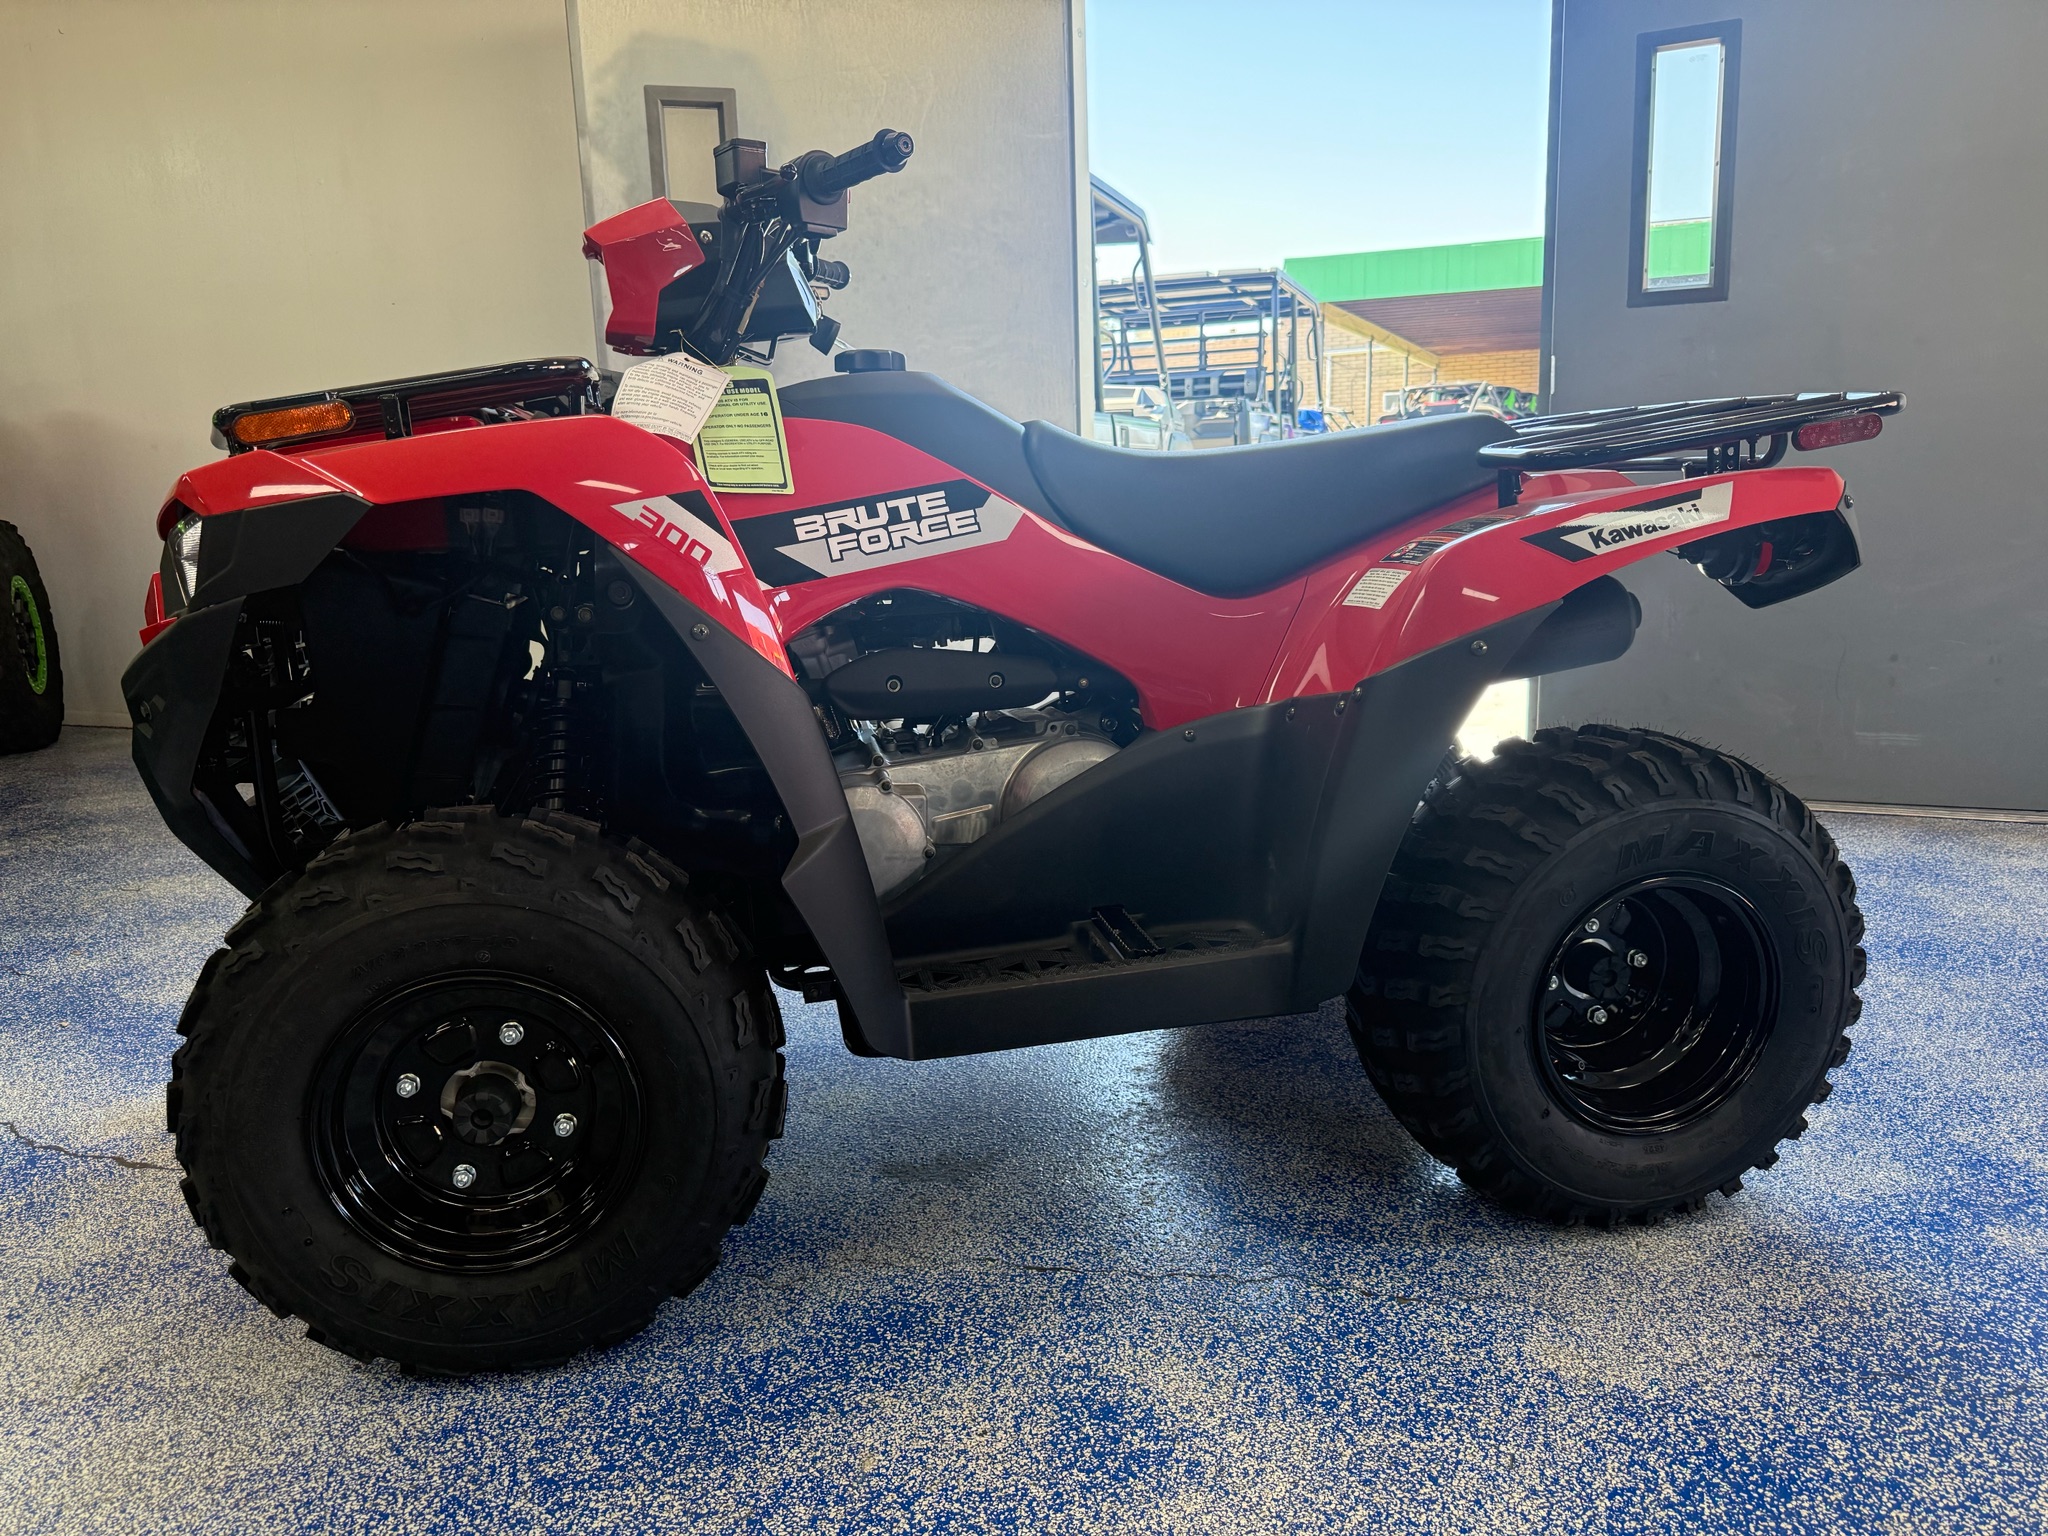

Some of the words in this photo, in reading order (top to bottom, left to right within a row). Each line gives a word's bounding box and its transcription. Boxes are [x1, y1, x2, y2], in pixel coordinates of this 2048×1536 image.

[668, 358, 704, 375] WARNING
[633, 504, 713, 567] 300
[792, 490, 950, 541] BRUTE
[826, 508, 981, 561] FORCE
[1588, 503, 1704, 549] Kawasaki
[1615, 829, 1828, 967] MAXXIS
[321, 1228, 640, 1329] MAXXIS
